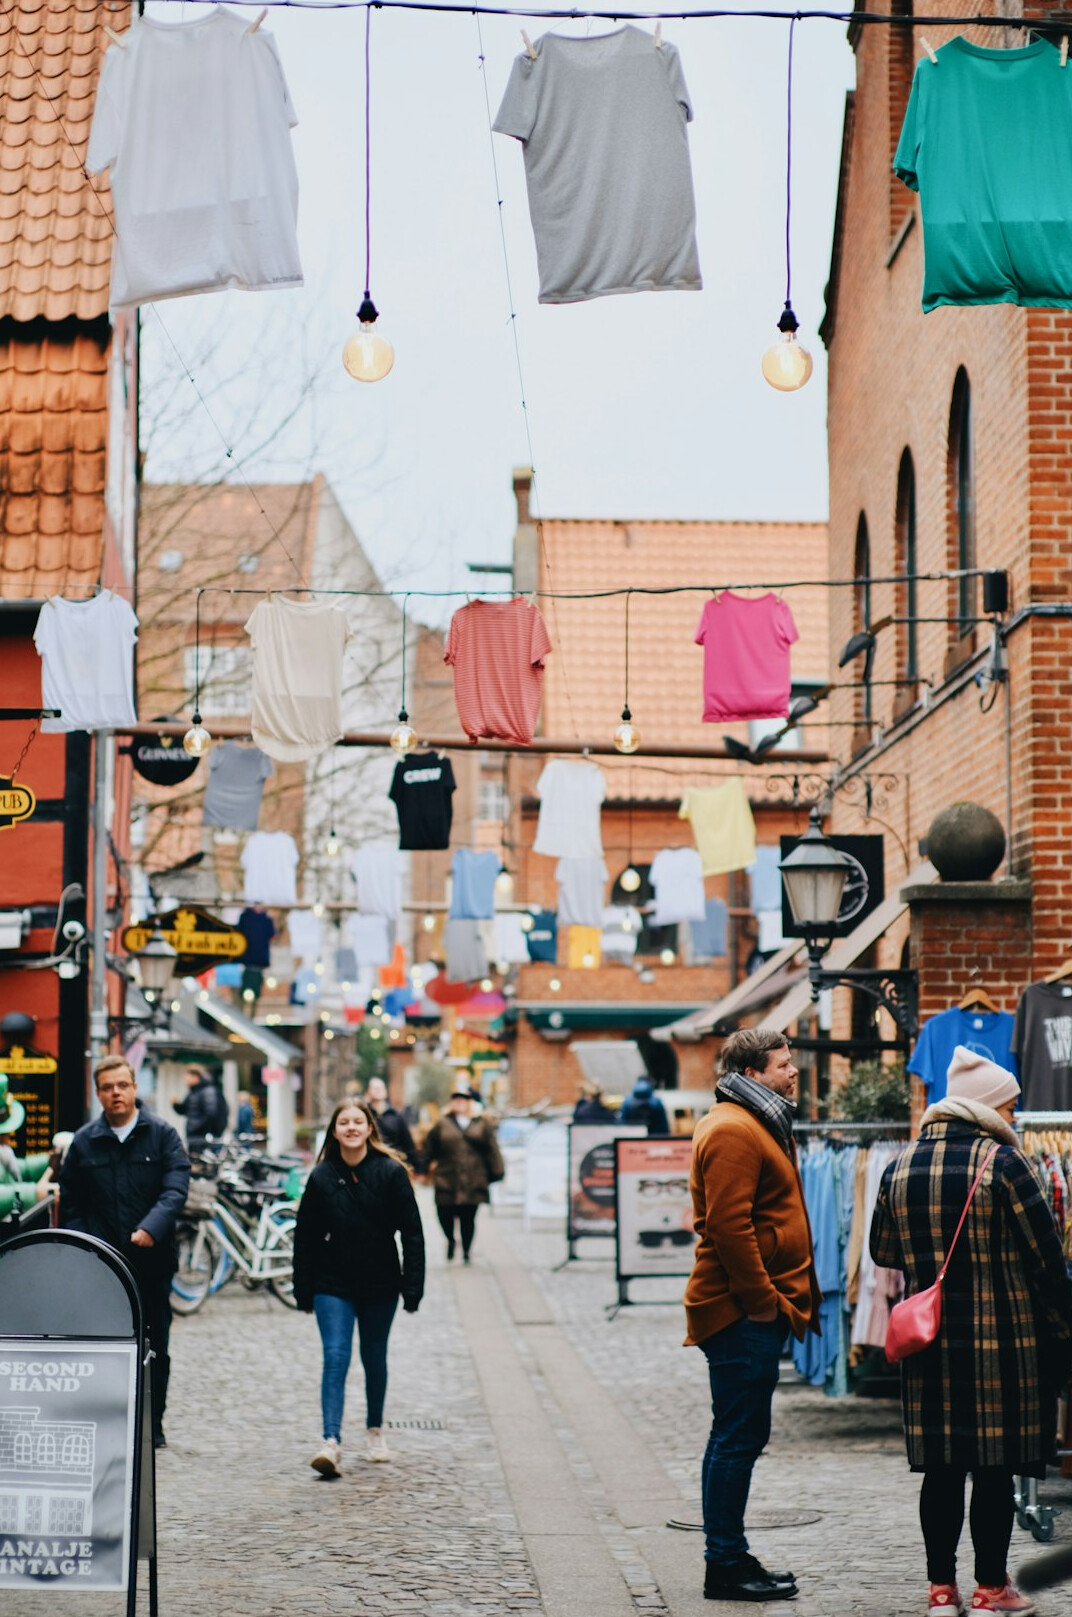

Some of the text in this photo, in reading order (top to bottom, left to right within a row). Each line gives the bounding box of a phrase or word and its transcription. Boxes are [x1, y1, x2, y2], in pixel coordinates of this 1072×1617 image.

[403, 767, 442, 784] CREW
[0, 794, 22, 809] UB
[0, 1361, 95, 1377] SECOND
[9, 1377, 81, 1392] HAND
[0, 1541, 93, 1557] ANALJE
[0, 1559, 92, 1576] INTAGE
